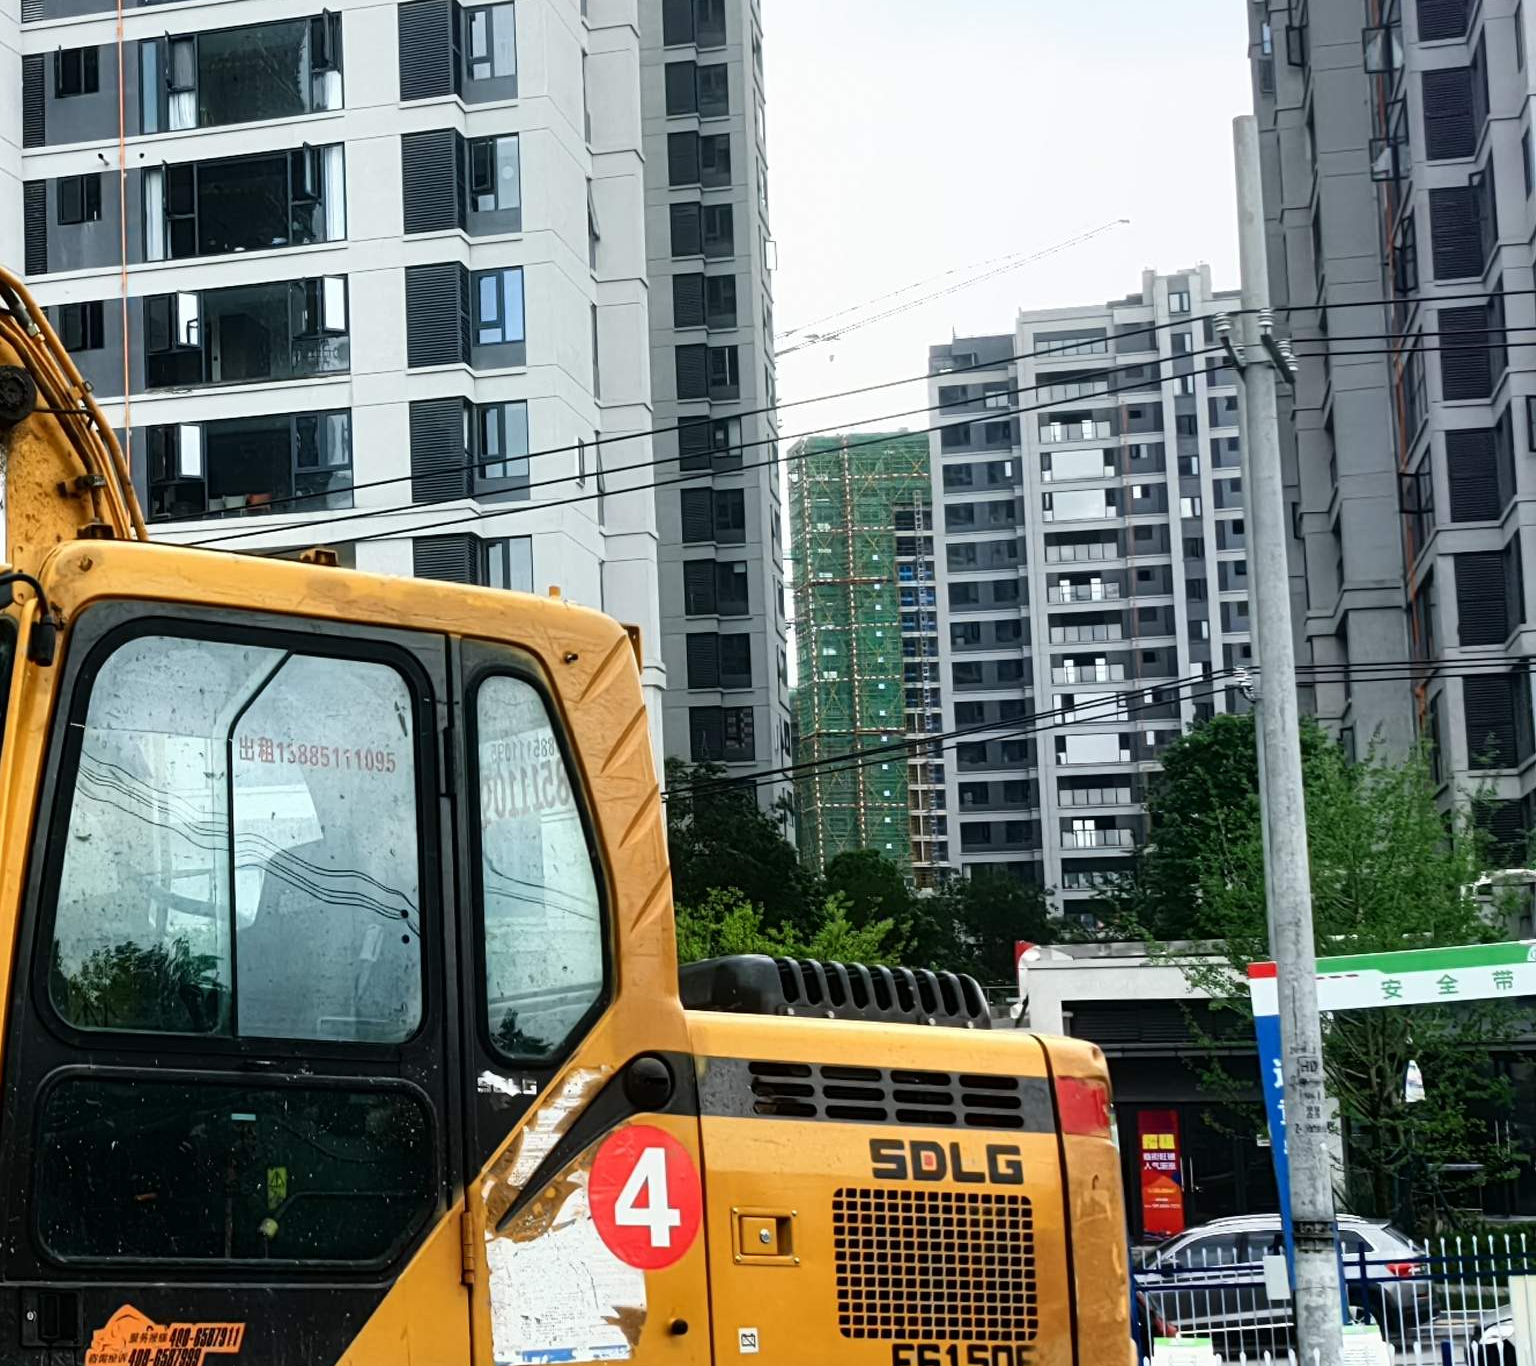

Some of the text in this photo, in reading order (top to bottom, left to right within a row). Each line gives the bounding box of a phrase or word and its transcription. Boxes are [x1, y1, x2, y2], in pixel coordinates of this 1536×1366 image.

[1380, 969, 1515, 1000] 安全带
[869, 1138, 1024, 1185] SDLG
[615, 1147, 681, 1248] 4
[168, 1327, 241, 1348] 400-6587911
